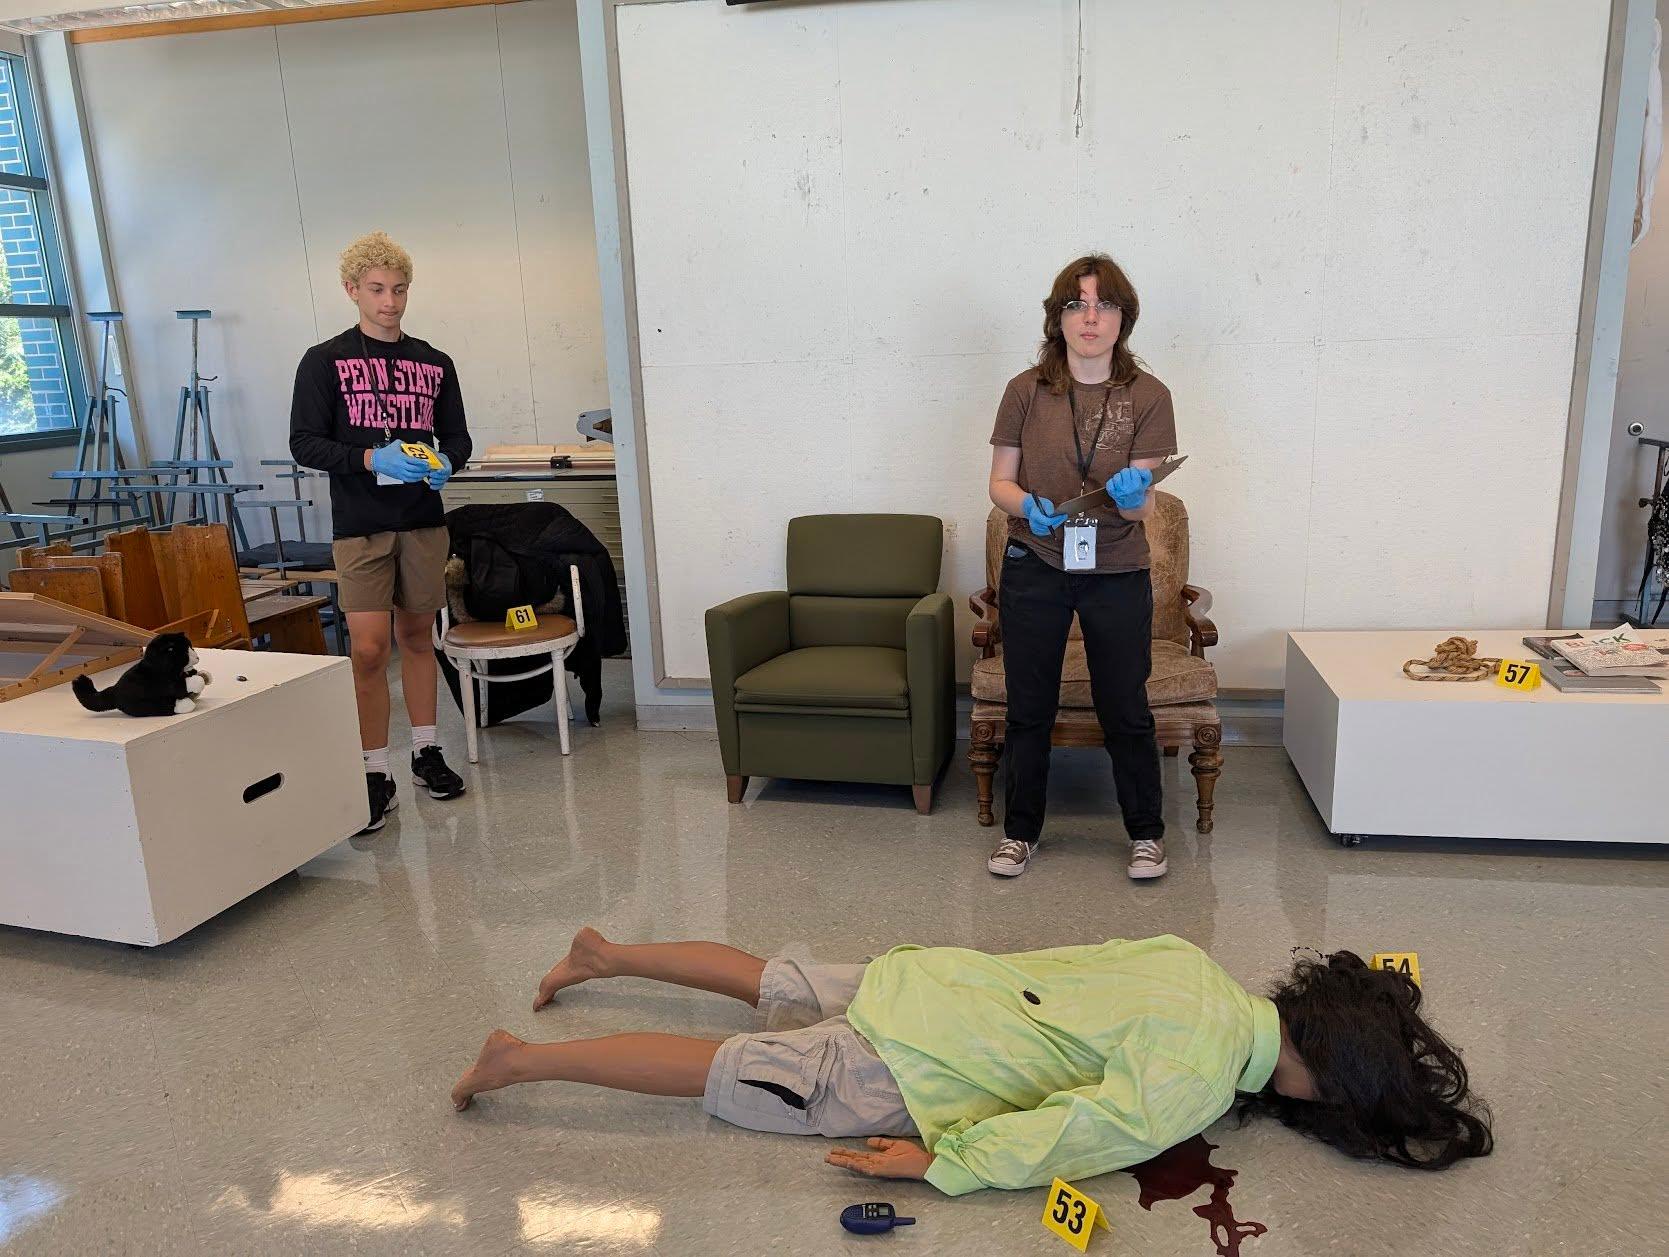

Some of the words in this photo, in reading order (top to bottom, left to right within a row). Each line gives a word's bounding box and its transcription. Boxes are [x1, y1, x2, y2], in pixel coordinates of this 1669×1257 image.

[335, 358, 389, 392] PENN
[394, 359, 444, 399] STATE
[344, 392, 434, 432] WRESTLIN
[515, 608, 531, 624] 61
[1504, 663, 1531, 685] 57
[1382, 957, 1413, 977] 54
[1052, 1188, 1087, 1235] 53
